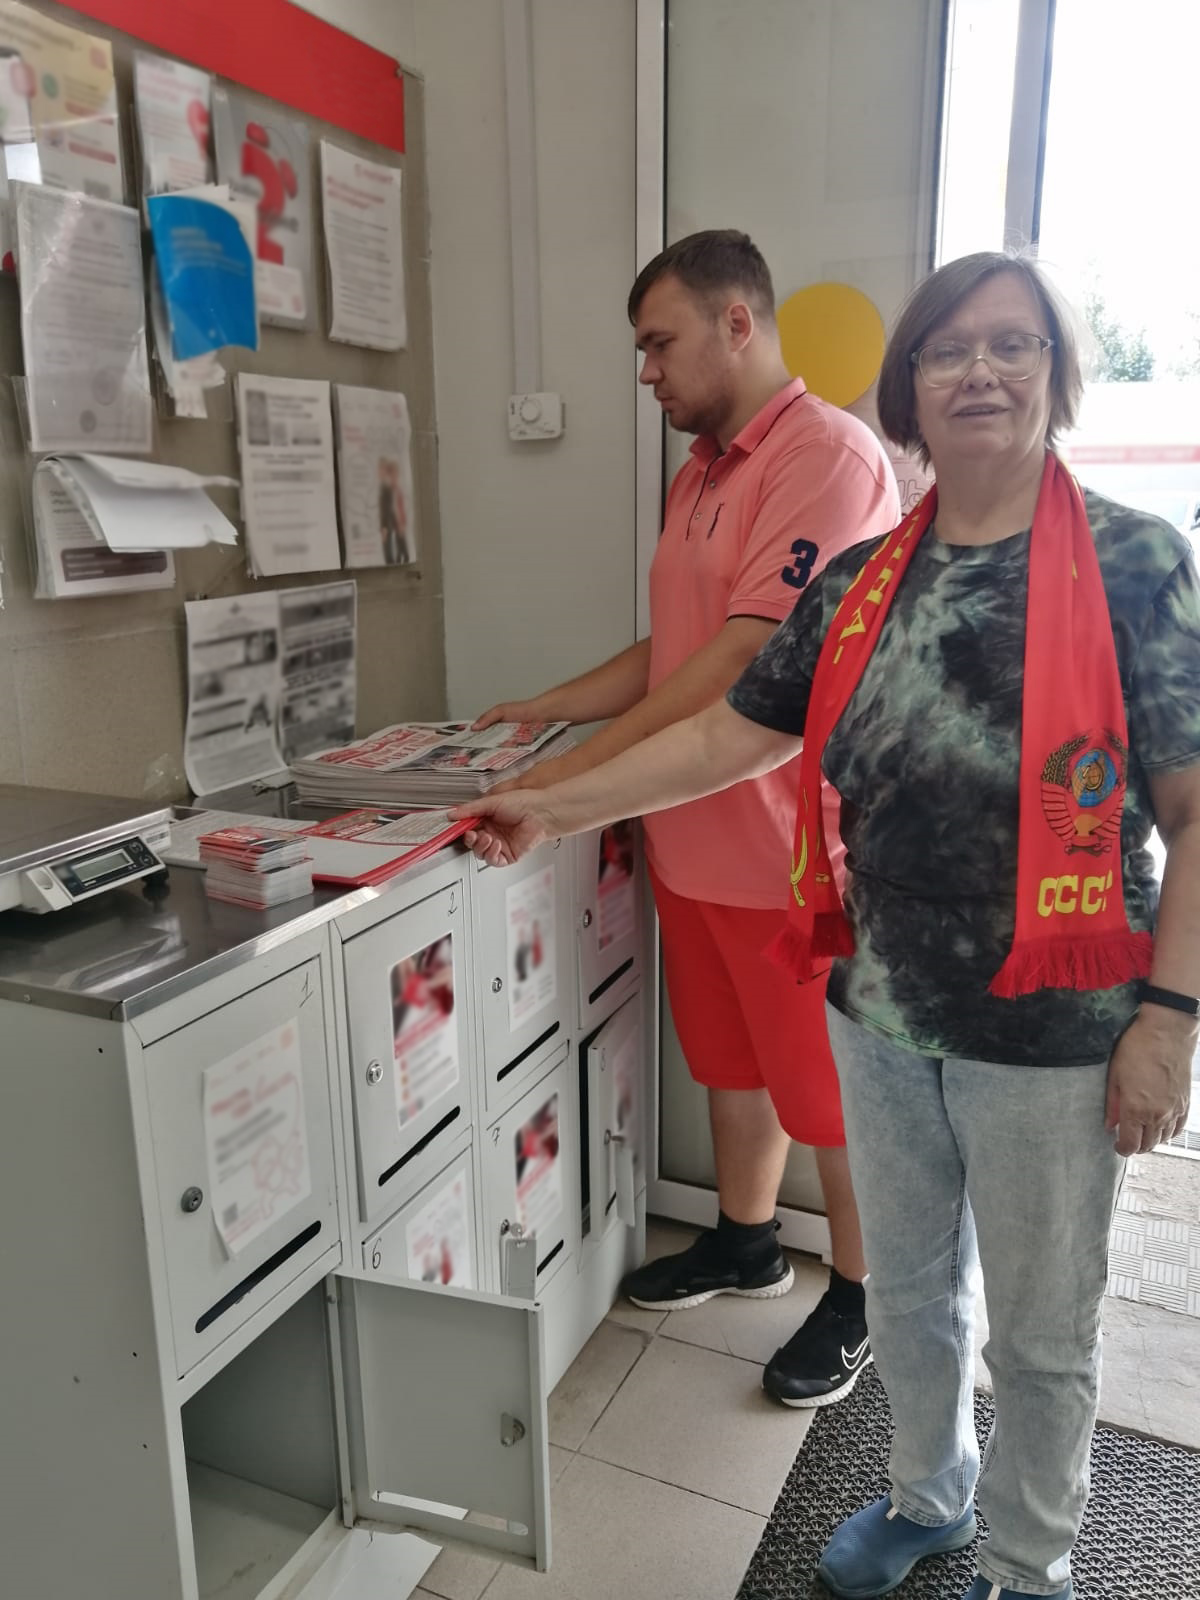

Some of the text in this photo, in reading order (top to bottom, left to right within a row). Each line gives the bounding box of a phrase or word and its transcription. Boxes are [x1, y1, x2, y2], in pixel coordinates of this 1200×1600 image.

[781, 538, 820, 589] 3
[448, 891, 458, 917] 2
[299, 971, 314, 1008] 1
[371, 1238, 382, 1269] 6
